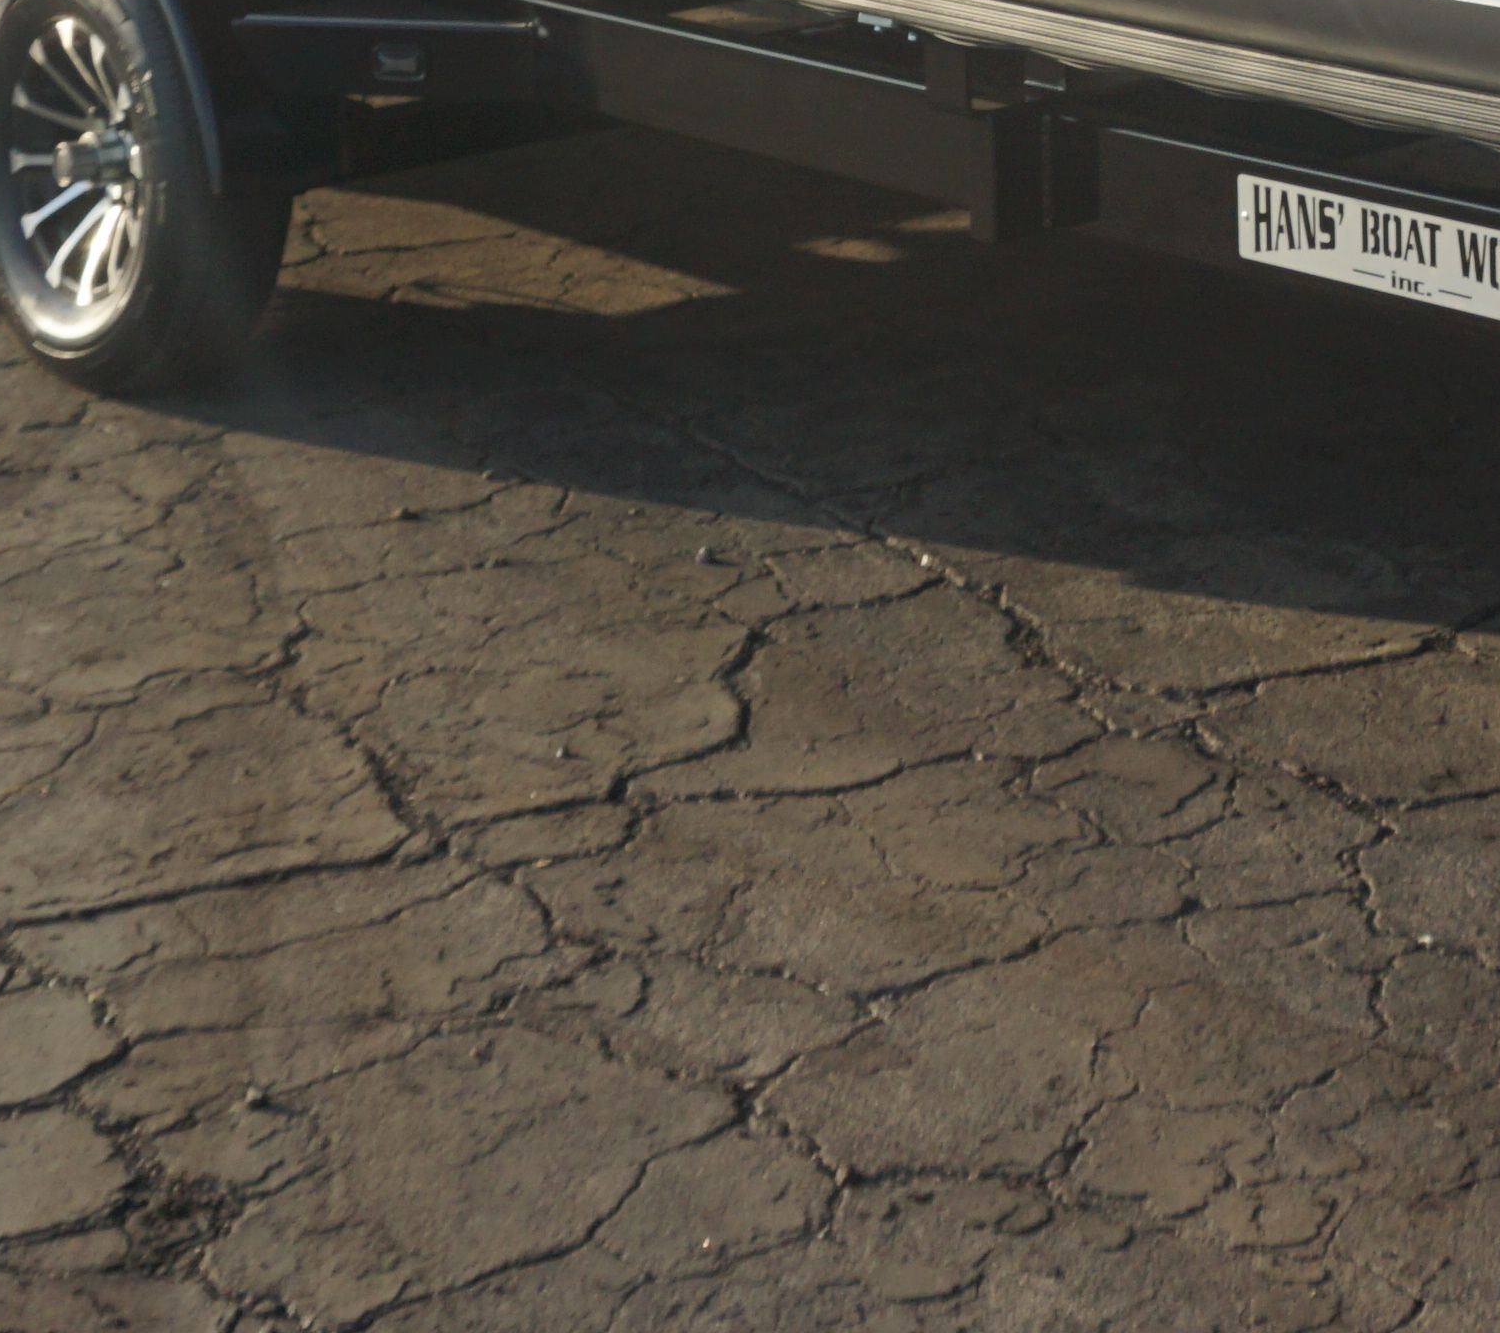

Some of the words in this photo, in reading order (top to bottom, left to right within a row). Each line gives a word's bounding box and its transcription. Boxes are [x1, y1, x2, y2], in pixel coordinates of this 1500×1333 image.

[1252, 184, 1345, 254] HANS'
[1360, 207, 1442, 269] BOAT
[1390, 270, 1433, 298] inc.
